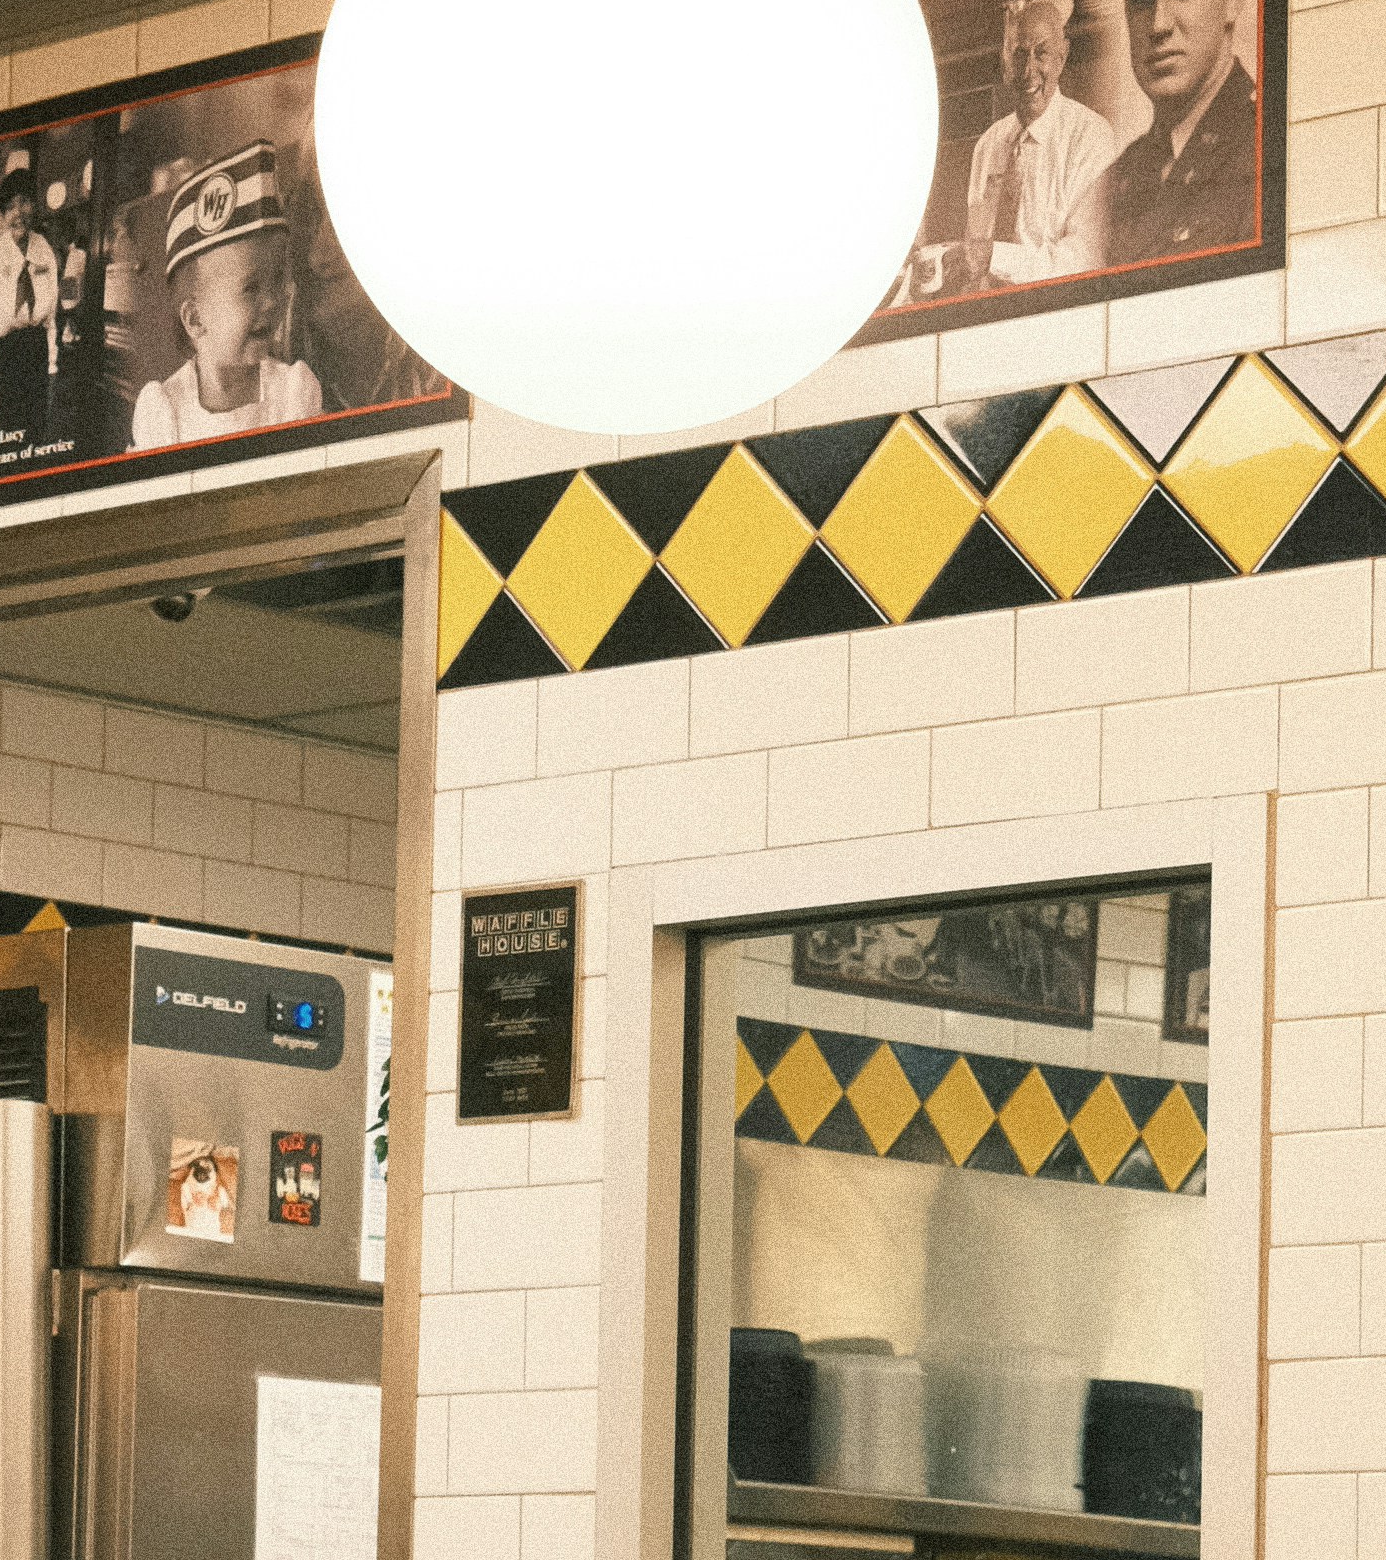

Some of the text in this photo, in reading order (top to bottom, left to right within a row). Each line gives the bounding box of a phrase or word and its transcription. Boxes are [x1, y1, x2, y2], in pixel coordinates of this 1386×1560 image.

[0, 428, 26, 444] Lucy
[20, 443, 34, 460] of
[34, 438, 75, 457] service
[472, 909, 568, 934] WAFFLE
